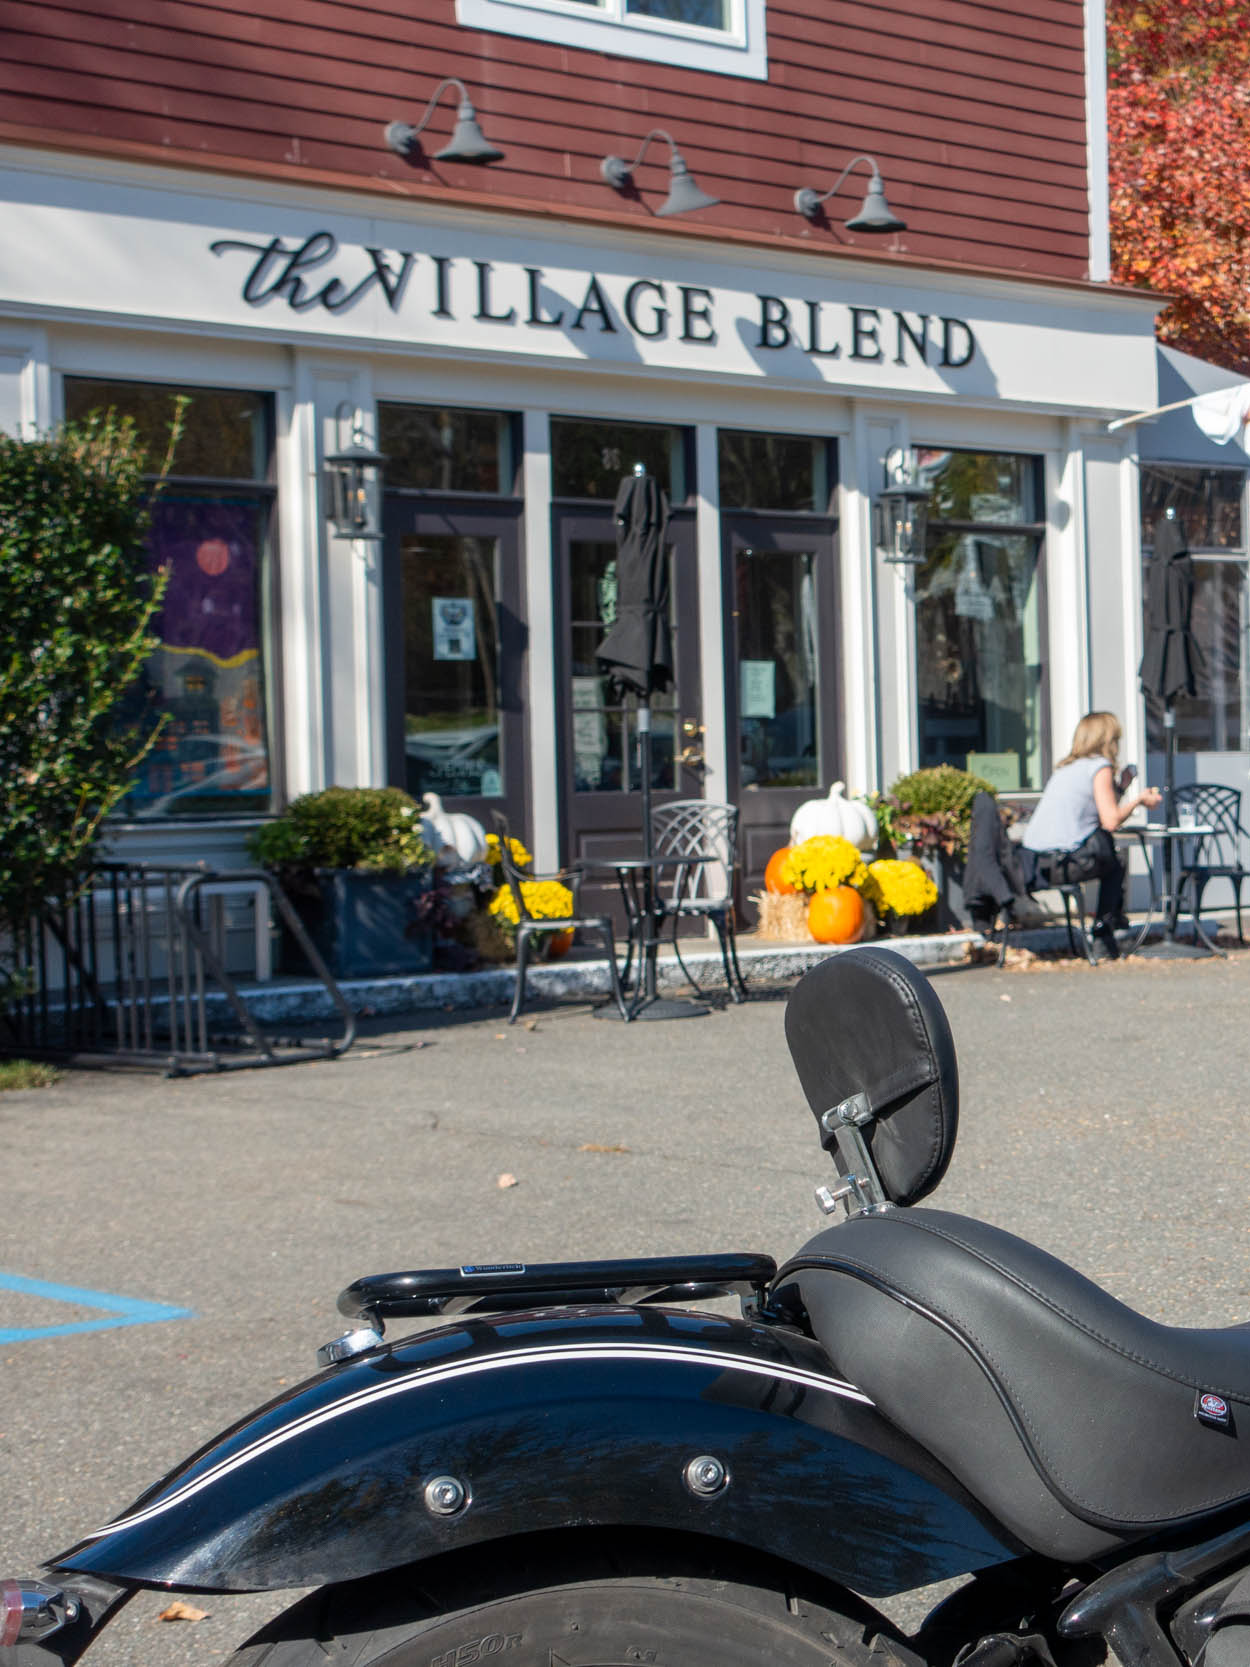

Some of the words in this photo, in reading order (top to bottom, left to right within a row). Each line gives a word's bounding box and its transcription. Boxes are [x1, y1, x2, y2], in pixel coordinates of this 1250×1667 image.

[210, 232, 388, 311] the
[364, 248, 715, 343] VILLAGE
[755, 295, 976, 368] BLEND
